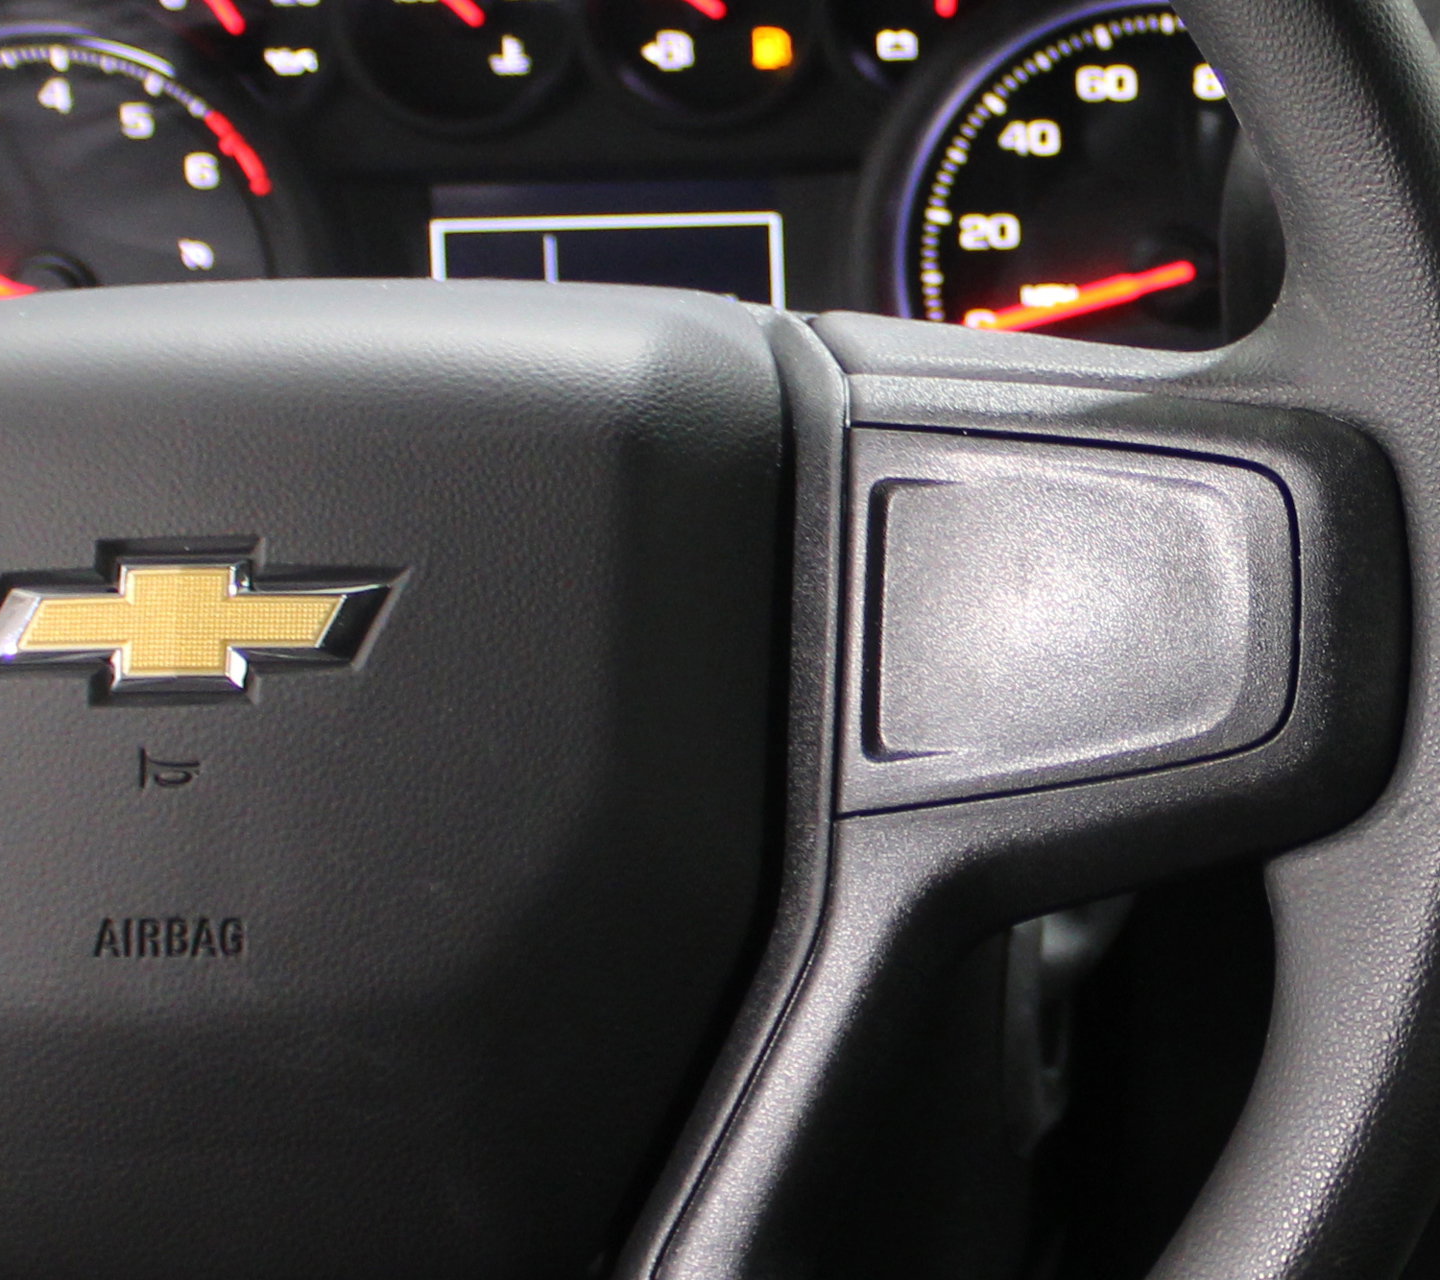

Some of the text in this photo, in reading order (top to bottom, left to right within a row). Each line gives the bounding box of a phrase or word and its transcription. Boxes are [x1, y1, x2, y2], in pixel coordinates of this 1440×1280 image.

[37, 77, 73, 114] 4
[1075, 64, 1139, 103] 60
[119, 102, 155, 140] 5
[998, 119, 1062, 157] 40
[184, 152, 220, 191] 6
[958, 213, 1022, 251] 20
[93, 916, 245, 958] AIRBAG
